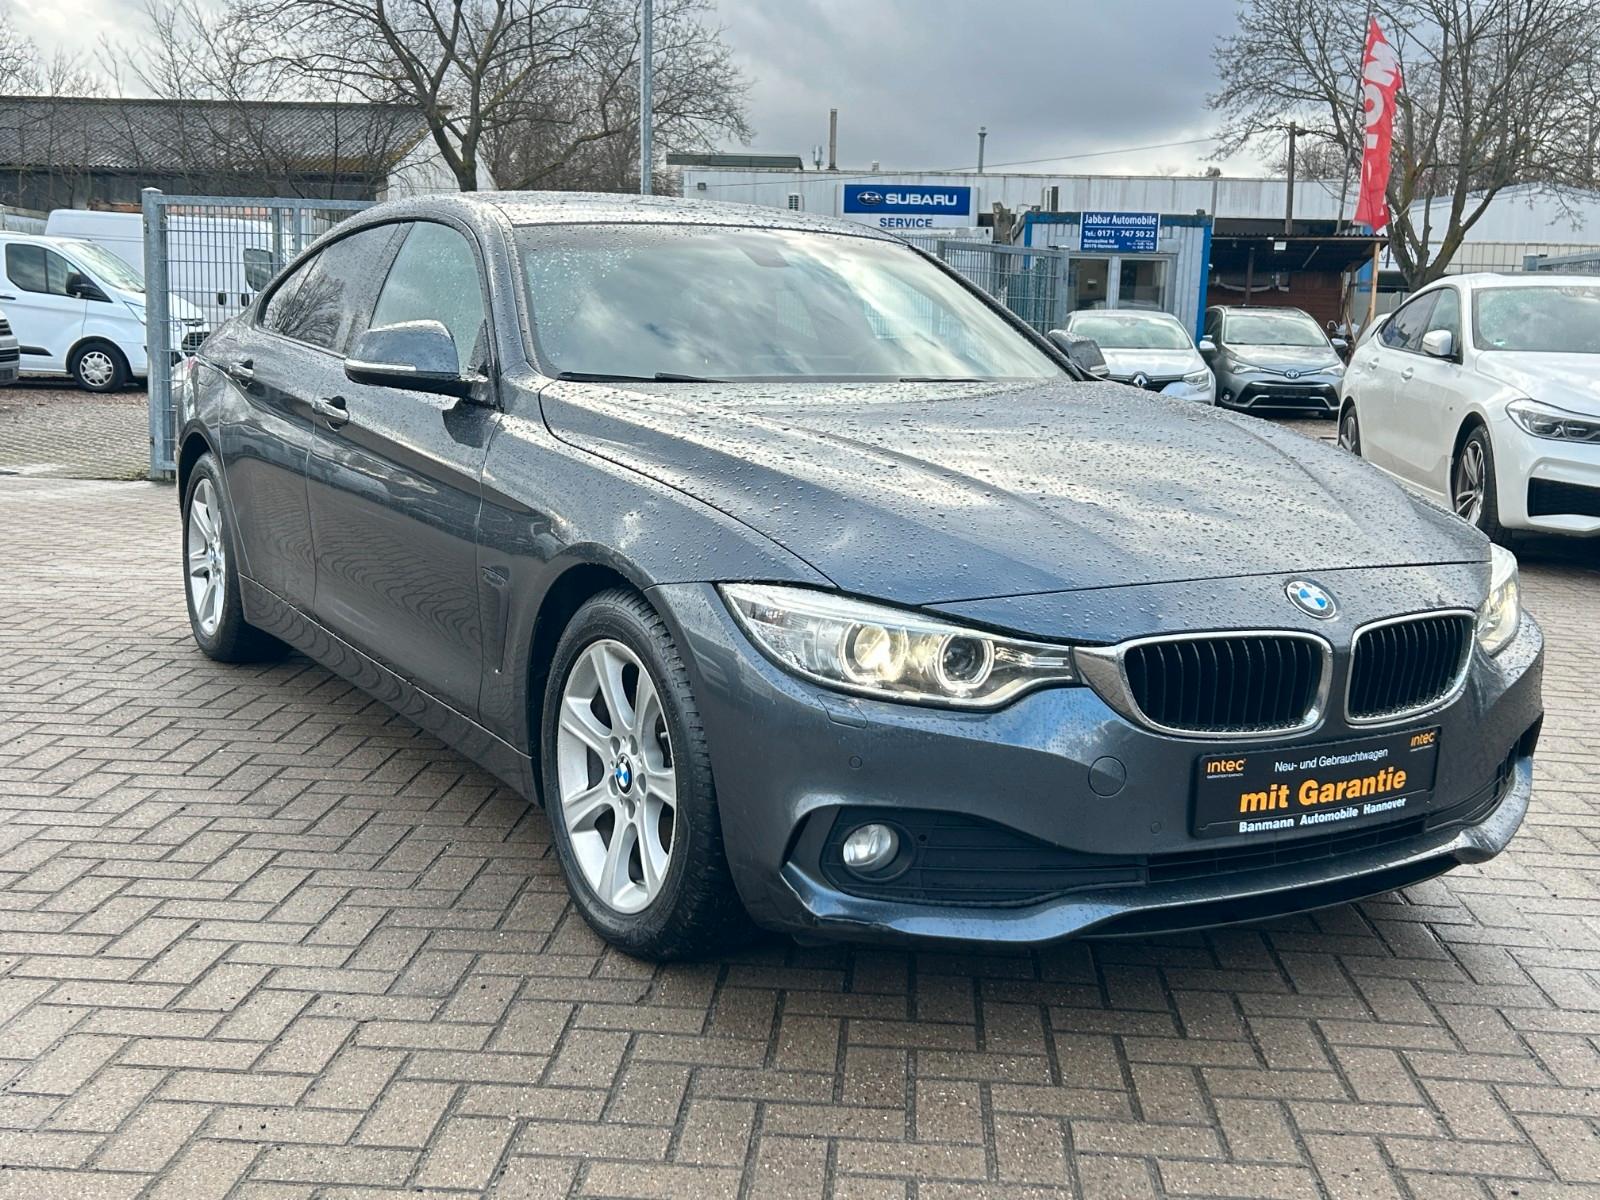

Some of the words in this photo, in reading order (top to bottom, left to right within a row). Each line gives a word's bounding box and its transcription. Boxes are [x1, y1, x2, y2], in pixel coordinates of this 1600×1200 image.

[885, 193, 957, 206] SUBARU
[879, 217, 933, 228] SERVICE
[1084, 214, 1111, 224] Jabbar
[1112, 215, 1157, 225] Automobile
[1275, 761, 1298, 773] Neu-
[1299, 757, 1317, 770] und
[1318, 748, 1388, 767] Gebrauchtwagen
[1239, 783, 1290, 813] mit
[1298, 766, 1407, 806] Garantie
[1238, 818, 1295, 833] Banmann
[1299, 806, 1359, 826] Automobile
[1363, 797, 1407, 815] Hannover
